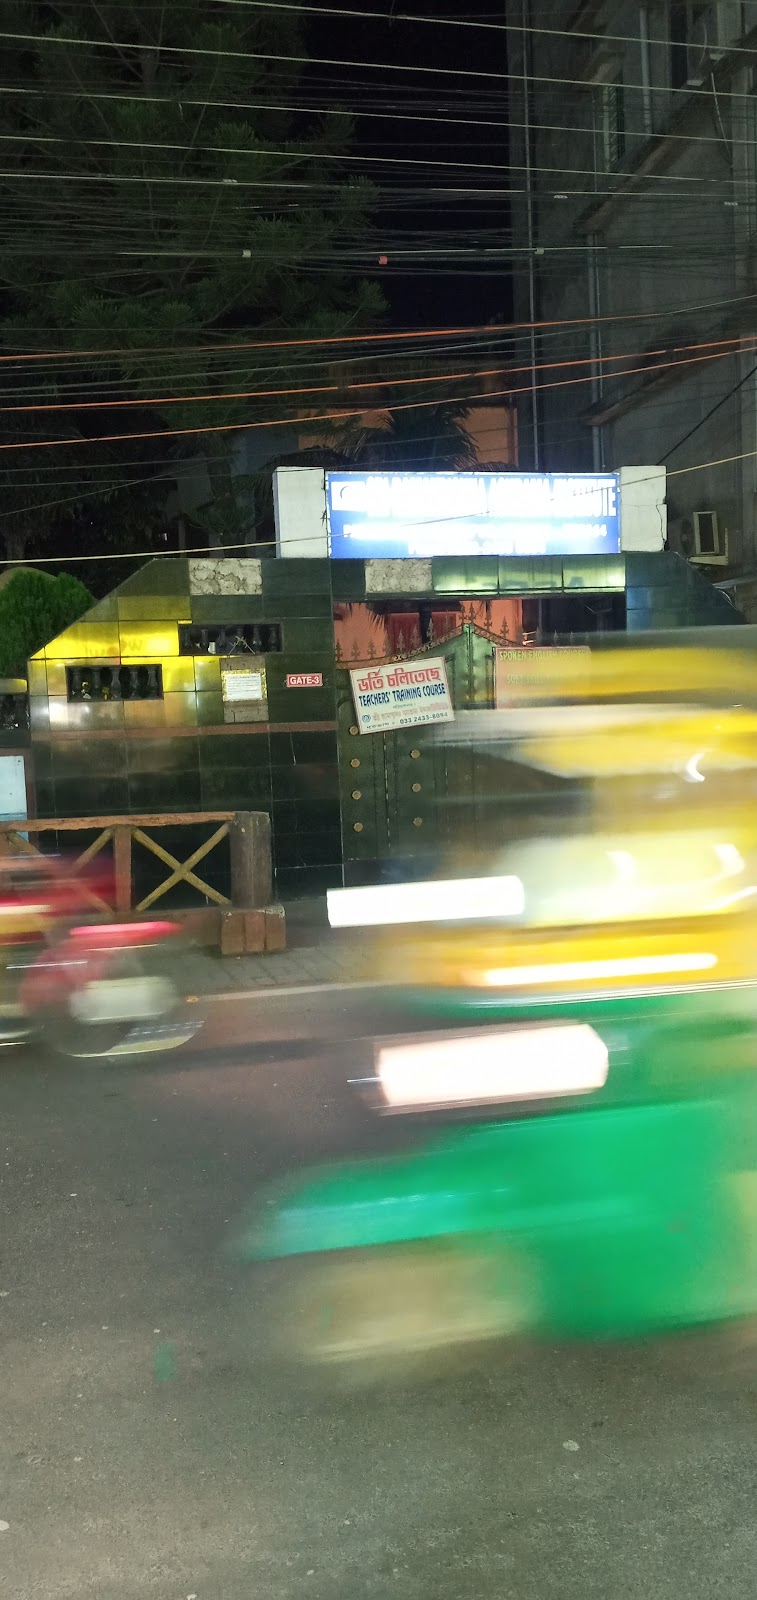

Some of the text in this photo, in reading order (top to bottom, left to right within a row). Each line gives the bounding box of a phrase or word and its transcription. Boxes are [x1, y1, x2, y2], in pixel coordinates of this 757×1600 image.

[499, 651, 527, 661] SPOKEN
[289, 676, 320, 685] GATE-3
[357, 667, 441, 691] ভর্তি চলিতেছে
[358, 683, 446, 707] TEACHERS' TRAINING COURSE
[399, 716, 412, 725] 033
